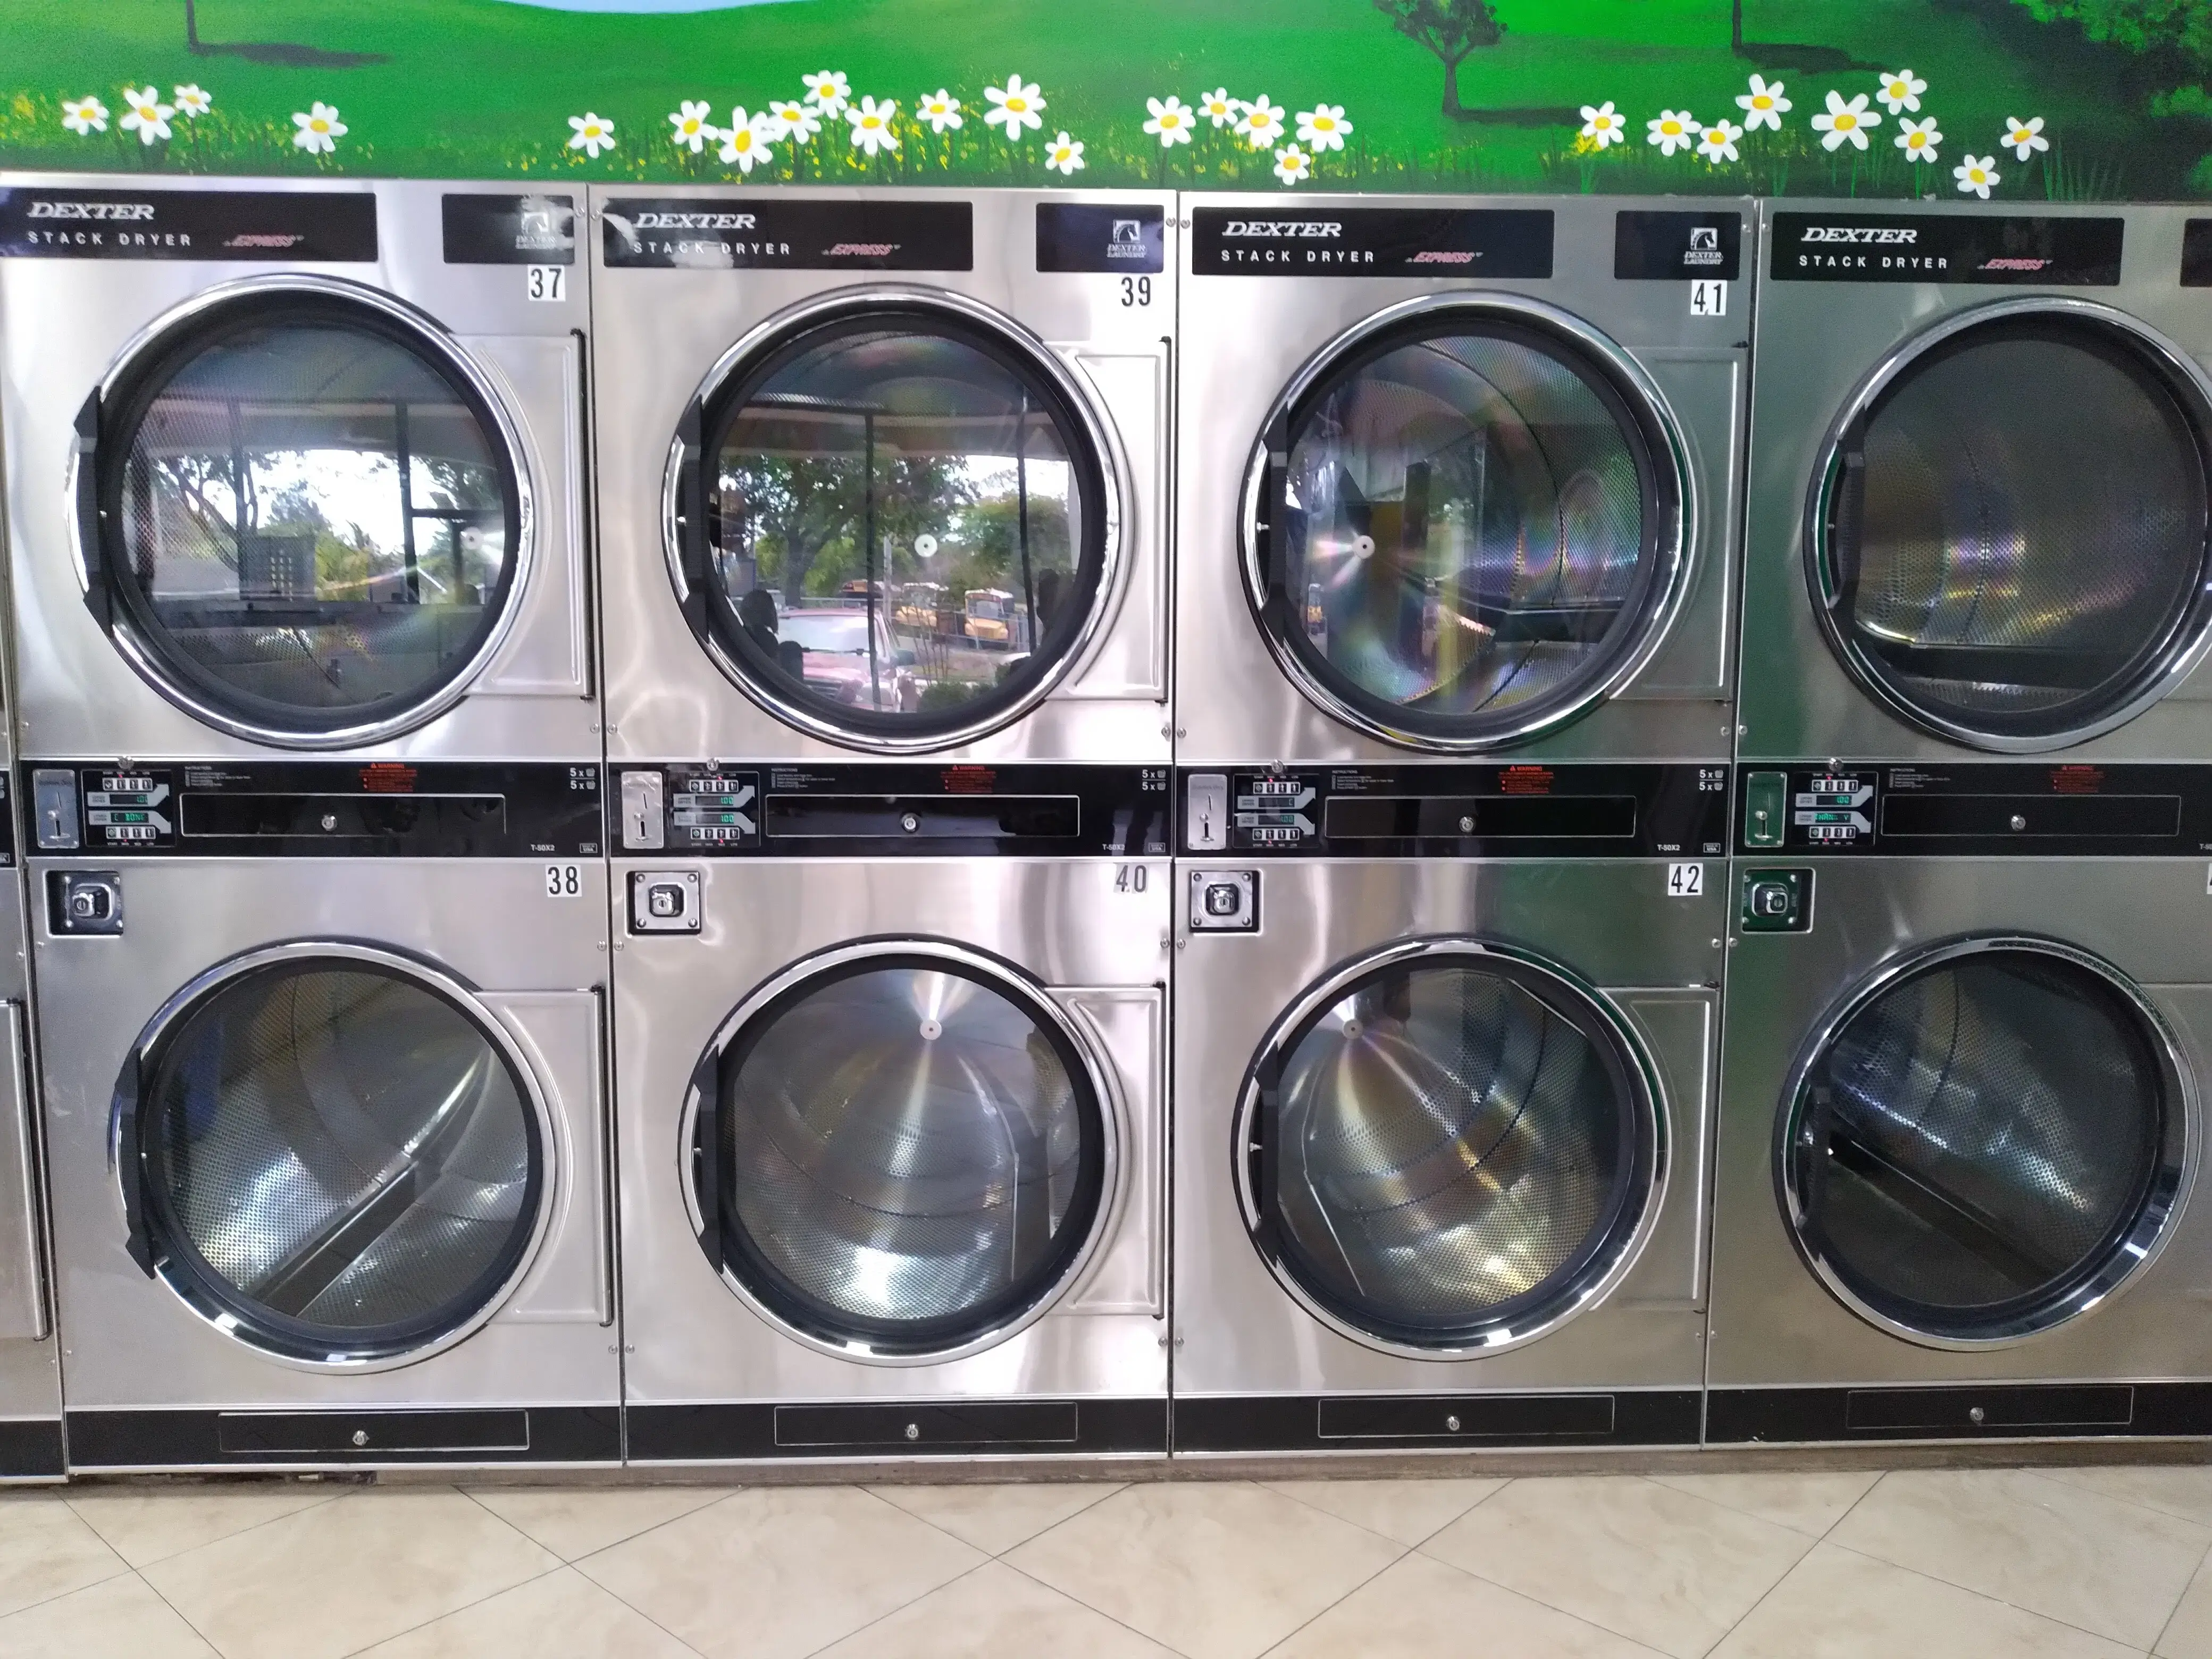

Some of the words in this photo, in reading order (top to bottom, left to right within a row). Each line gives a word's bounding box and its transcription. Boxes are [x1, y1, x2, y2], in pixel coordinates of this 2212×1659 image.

[27, 202, 155, 220] DEXTER
[633, 213, 756, 229] DEXTER
[1221, 221, 1342, 237] DEXTER
[1800, 227, 1917, 244] DEXTER
[28, 231, 103, 245] STACK
[119, 232, 191, 246] DRYER
[633, 242, 705, 254] STACK
[720, 243, 791, 255] DRYER
[1221, 249, 1291, 262] STACK
[1307, 250, 1373, 263] DRYER
[1799, 255, 1866, 267] STACK
[1882, 256, 1947, 269] DRYER
[530, 267, 562, 298] 37
[1120, 276, 1151, 307] 39
[1693, 282, 1722, 314] 41
[570, 767, 577, 777] 5
[1142, 769, 1149, 778] 5
[1699, 769, 1706, 778] 5
[570, 780, 577, 790] 5
[1142, 781, 1149, 791] 5
[1699, 781, 1706, 791] 5
[548, 866, 579, 895] 38
[1116, 865, 1147, 893] 40
[1671, 865, 1699, 893] 42
